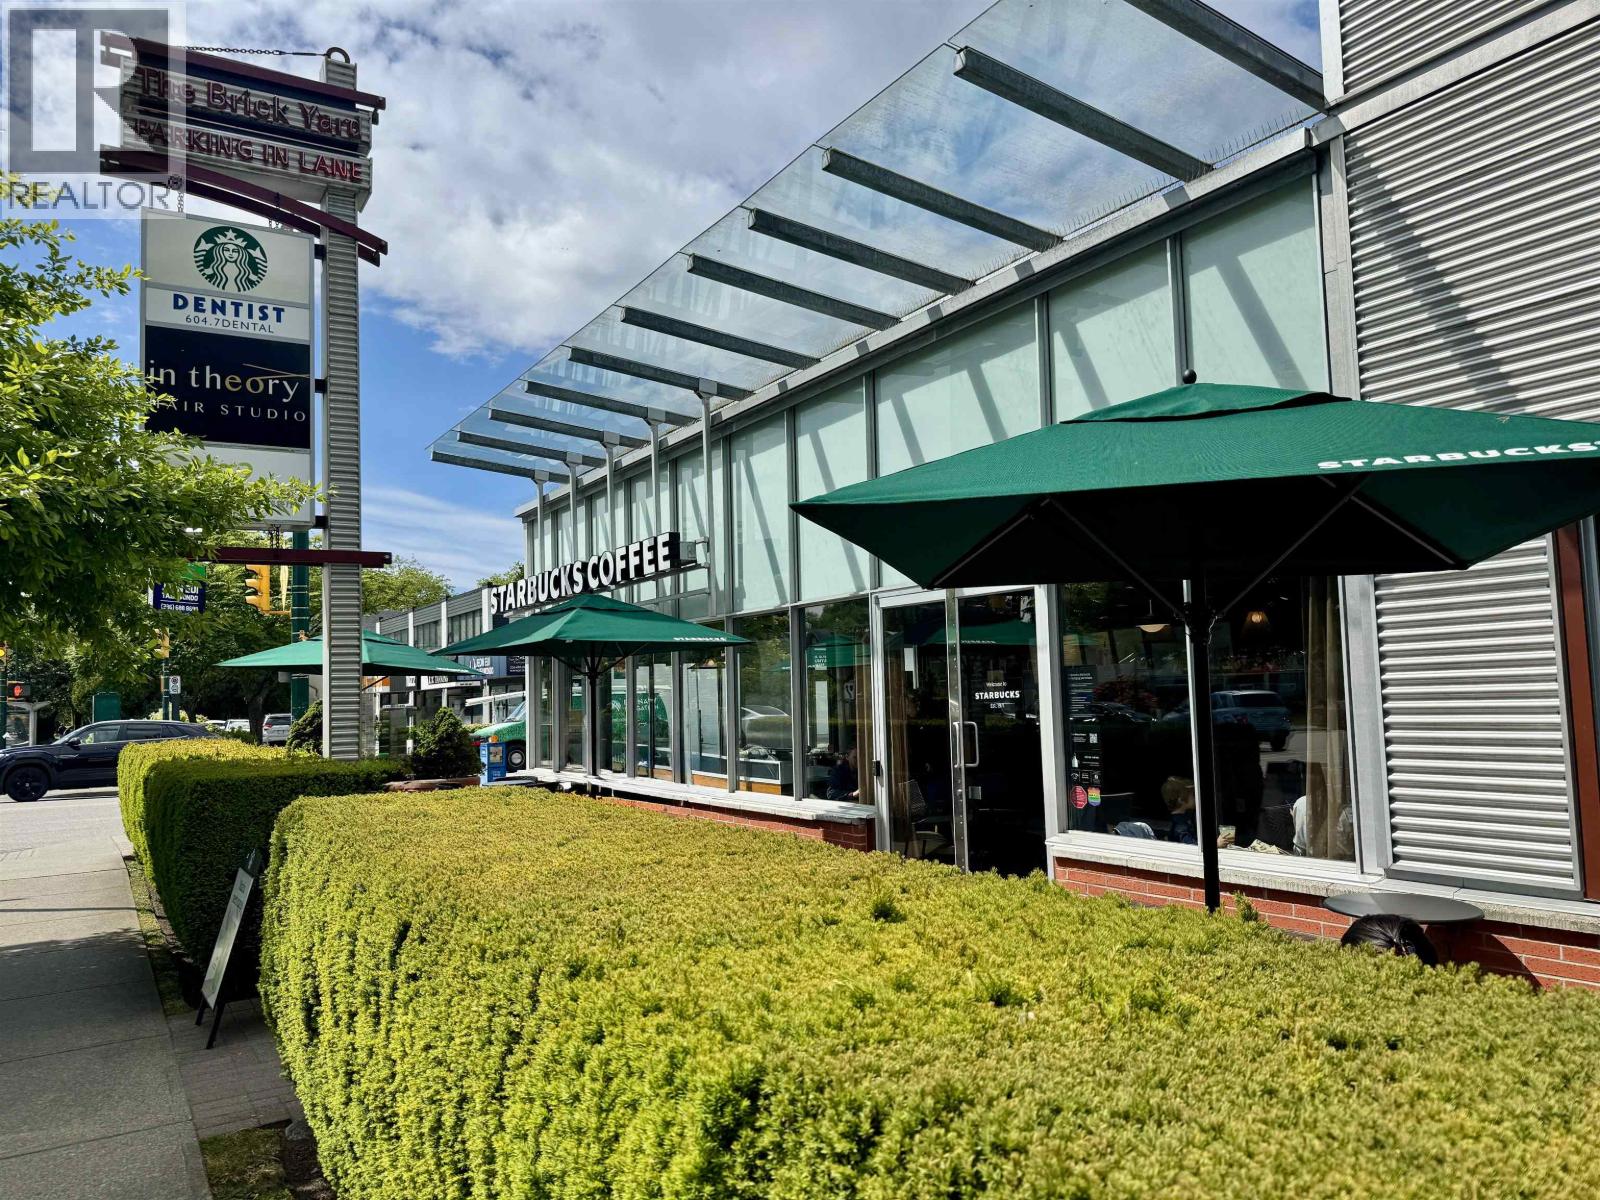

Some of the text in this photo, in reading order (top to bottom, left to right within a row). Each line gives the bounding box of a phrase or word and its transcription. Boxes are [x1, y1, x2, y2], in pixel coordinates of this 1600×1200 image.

[206, 80, 290, 124] Brick
[300, 102, 362, 139] Yard
[136, 119, 363, 183] PARKING IN LANE
[173, 293, 285, 323] DENTIST
[185, 315, 275, 333] 604.7DENTAL
[150, 360, 299, 402] in theory
[221, 404, 306, 422] STUDIO
[1317, 442, 1598, 470] STARBUCKS
[490, 533, 674, 616] STARBUCKS COFFEE
[975, 690, 1020, 700] STARBUCKS
